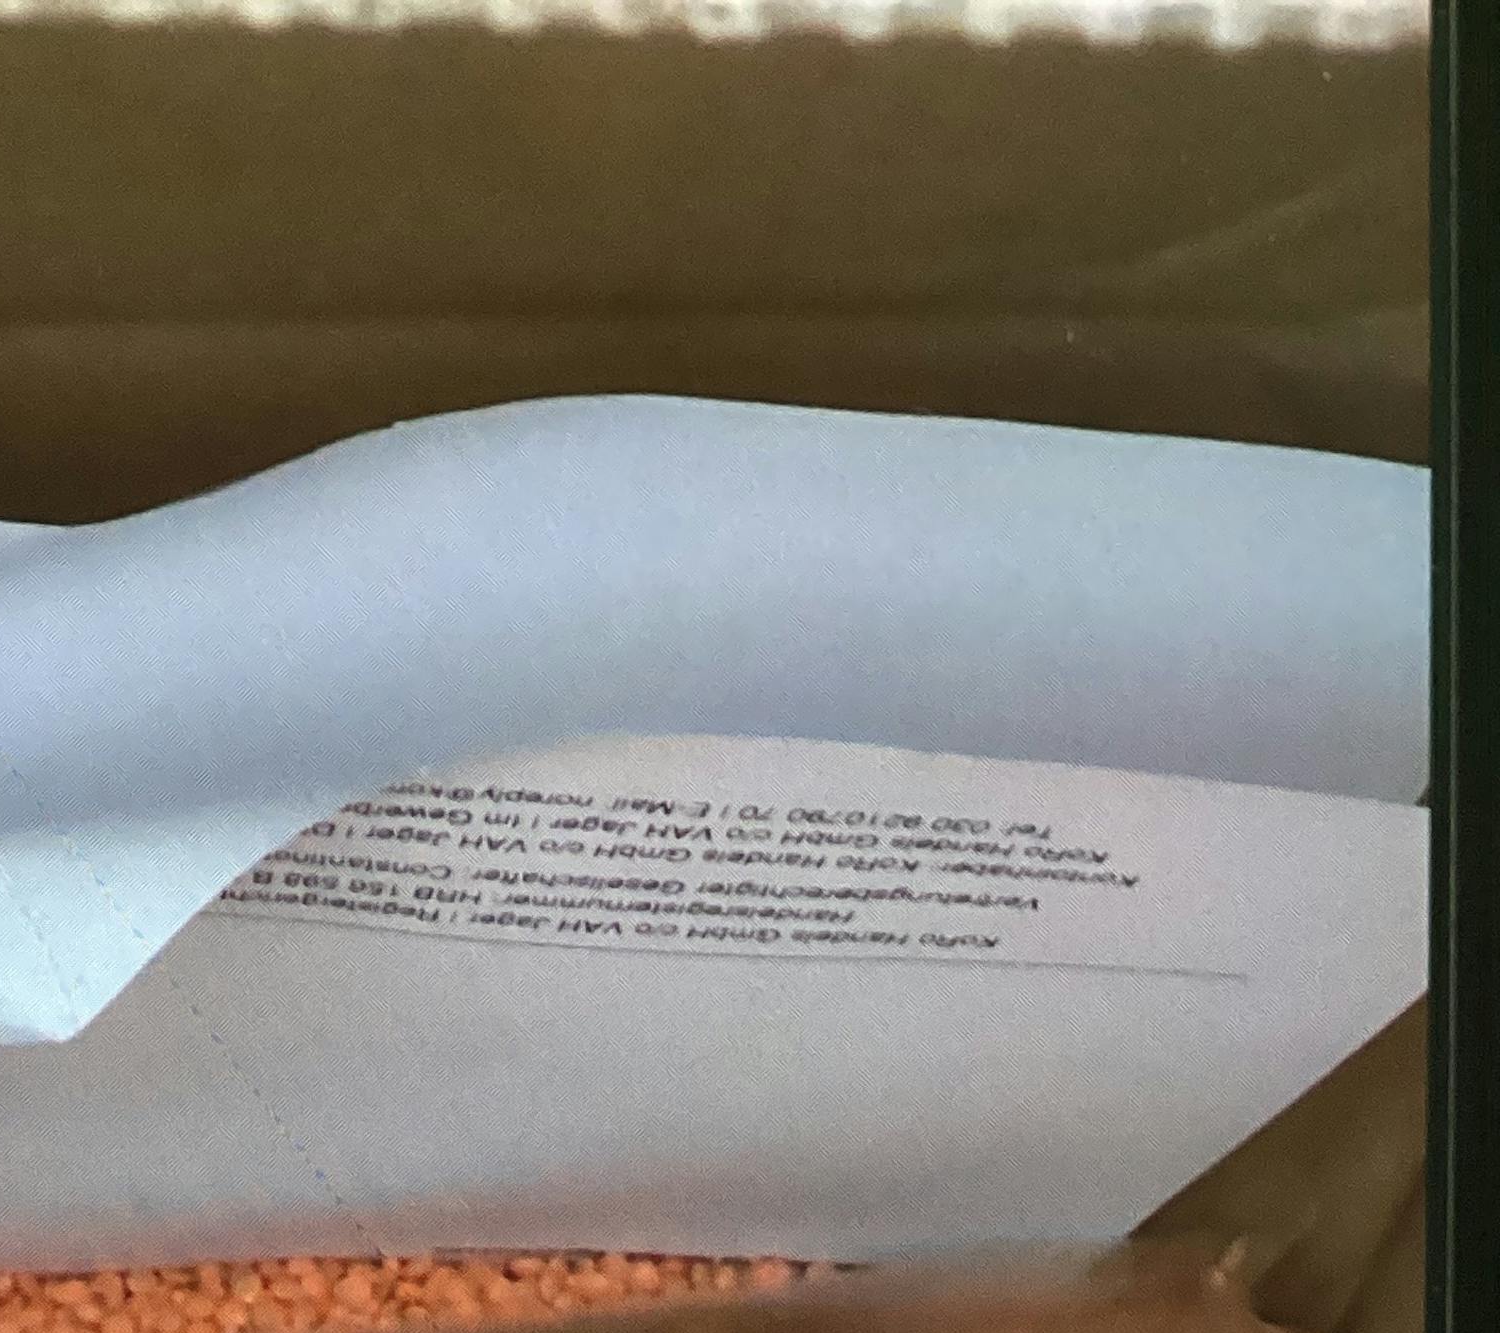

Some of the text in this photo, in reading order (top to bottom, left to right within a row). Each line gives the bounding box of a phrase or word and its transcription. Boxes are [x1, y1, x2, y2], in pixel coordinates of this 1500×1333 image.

[645, 823, 711, 841] VAH
[781, 831, 879, 849] GmbH
[458, 833, 527, 855] VAH
[593, 843, 691, 863] GmbH
[891, 838, 1015, 858] Handels
[702, 849, 826, 869] Handels
[836, 856, 919, 873] KoRo
[1024, 846, 1107, 865] KoRo
[557, 919, 624, 935] VAH
[687, 926, 781, 945] GmbH
[792, 929, 910, 947] Handels
